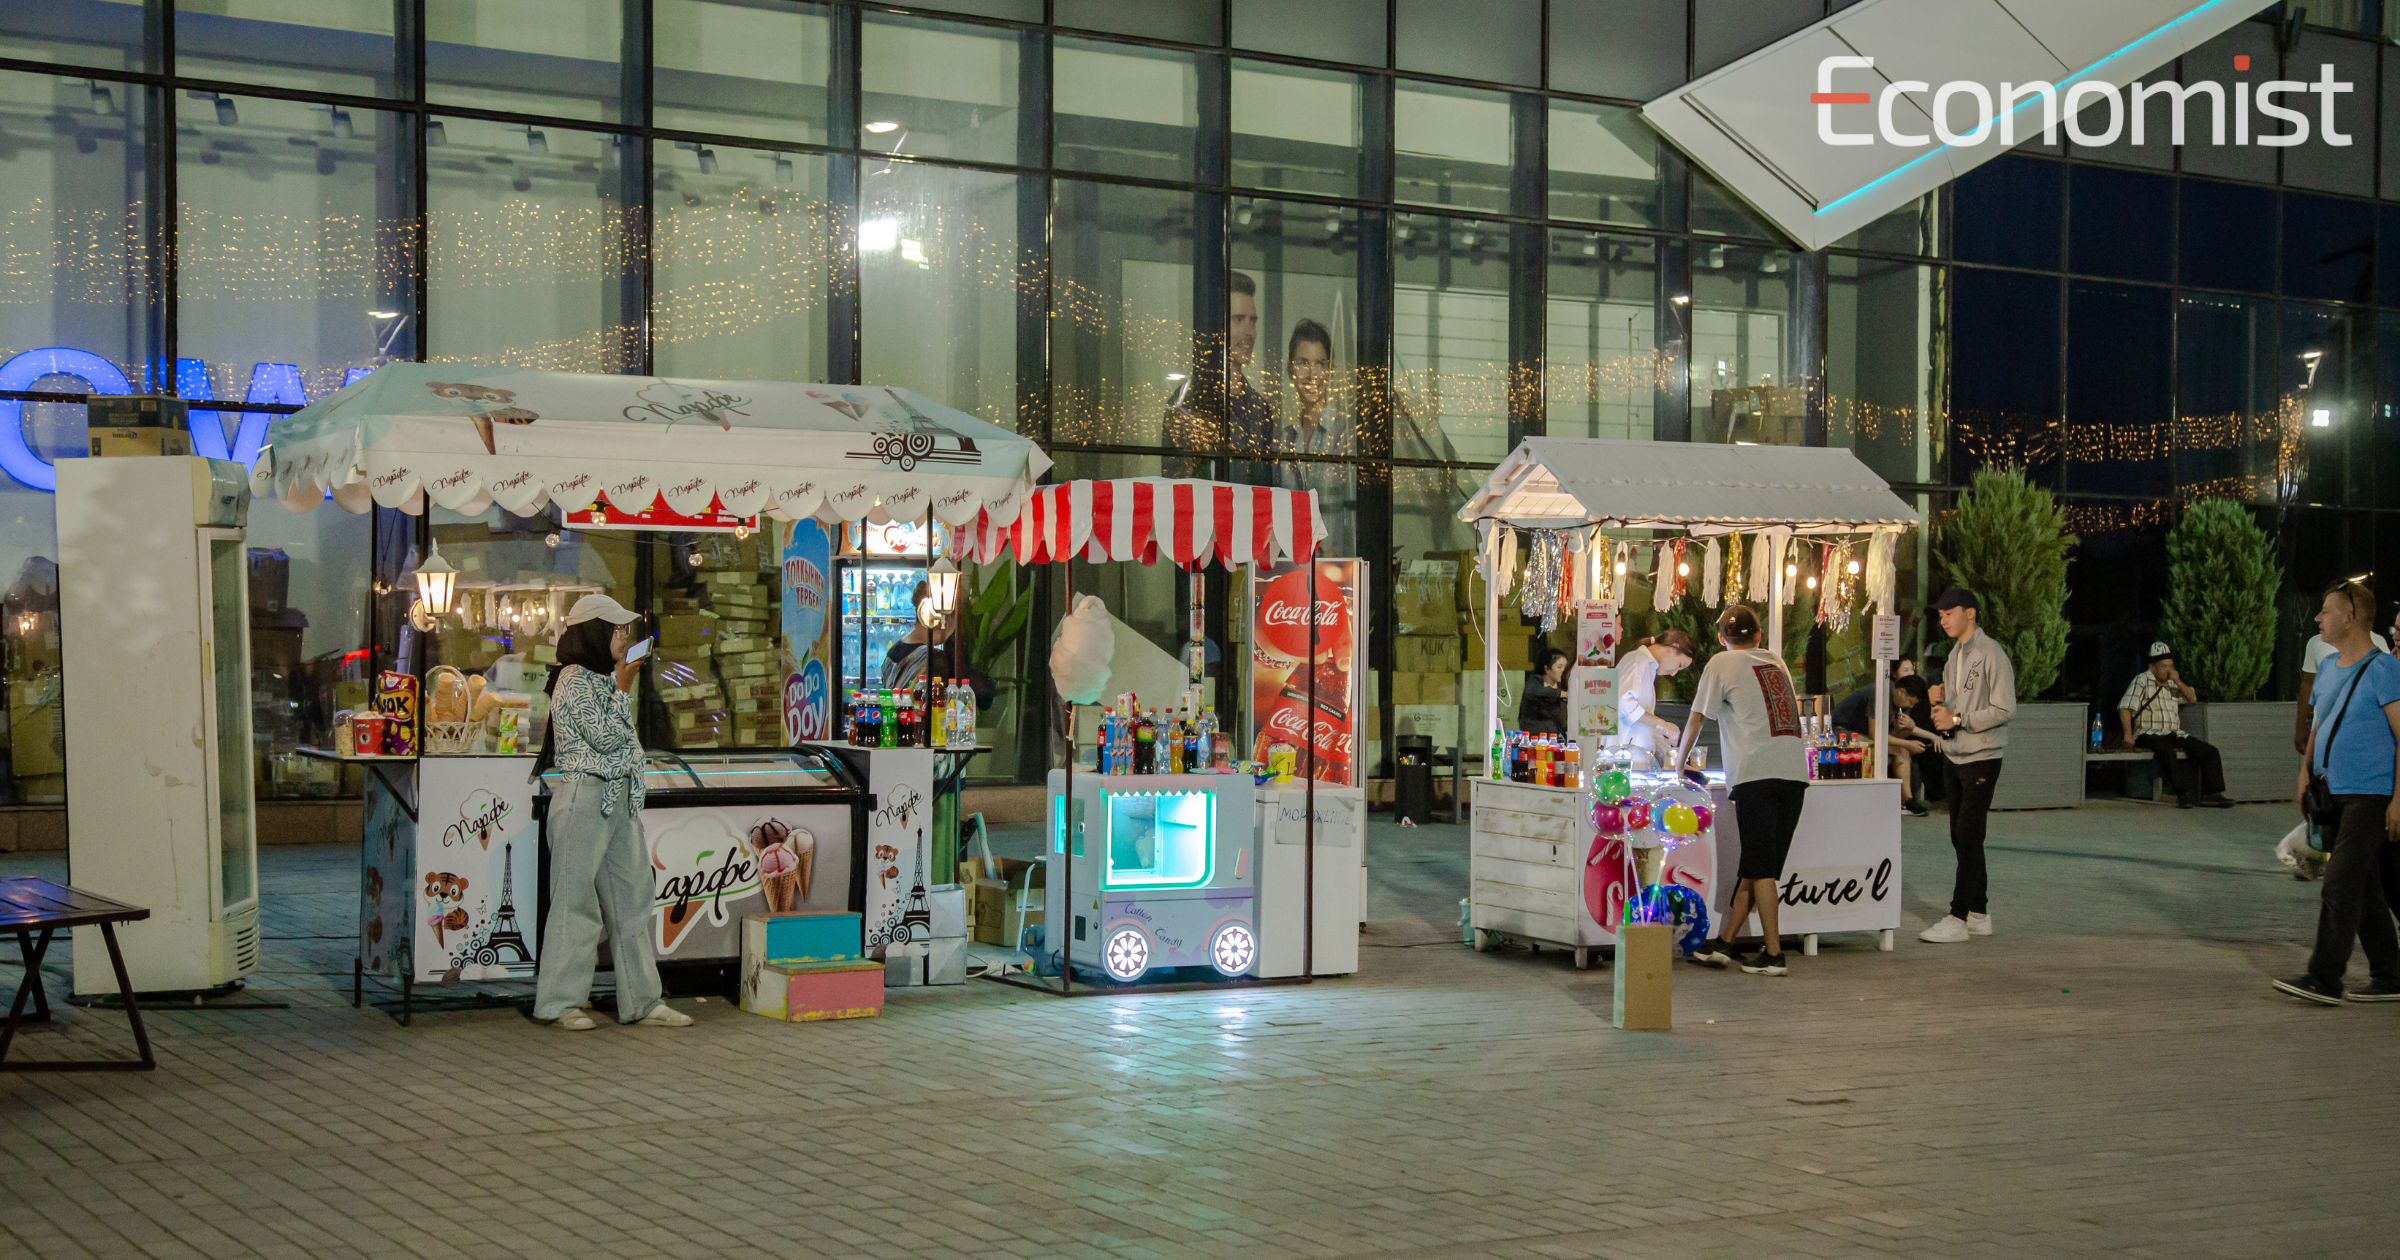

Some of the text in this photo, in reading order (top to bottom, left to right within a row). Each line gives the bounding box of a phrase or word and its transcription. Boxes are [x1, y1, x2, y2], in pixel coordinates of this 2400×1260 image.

[1264, 600, 1343, 626] Coca-Cola
[787, 696, 823, 747] Day
[1269, 707, 1340, 750] CocaCola
[442, 797, 509, 848] Парфе
[1279, 806, 1350, 826] МОРЖЕНОЕ
[651, 846, 759, 924] арфе
[1154, 926, 1183, 949] Candy
